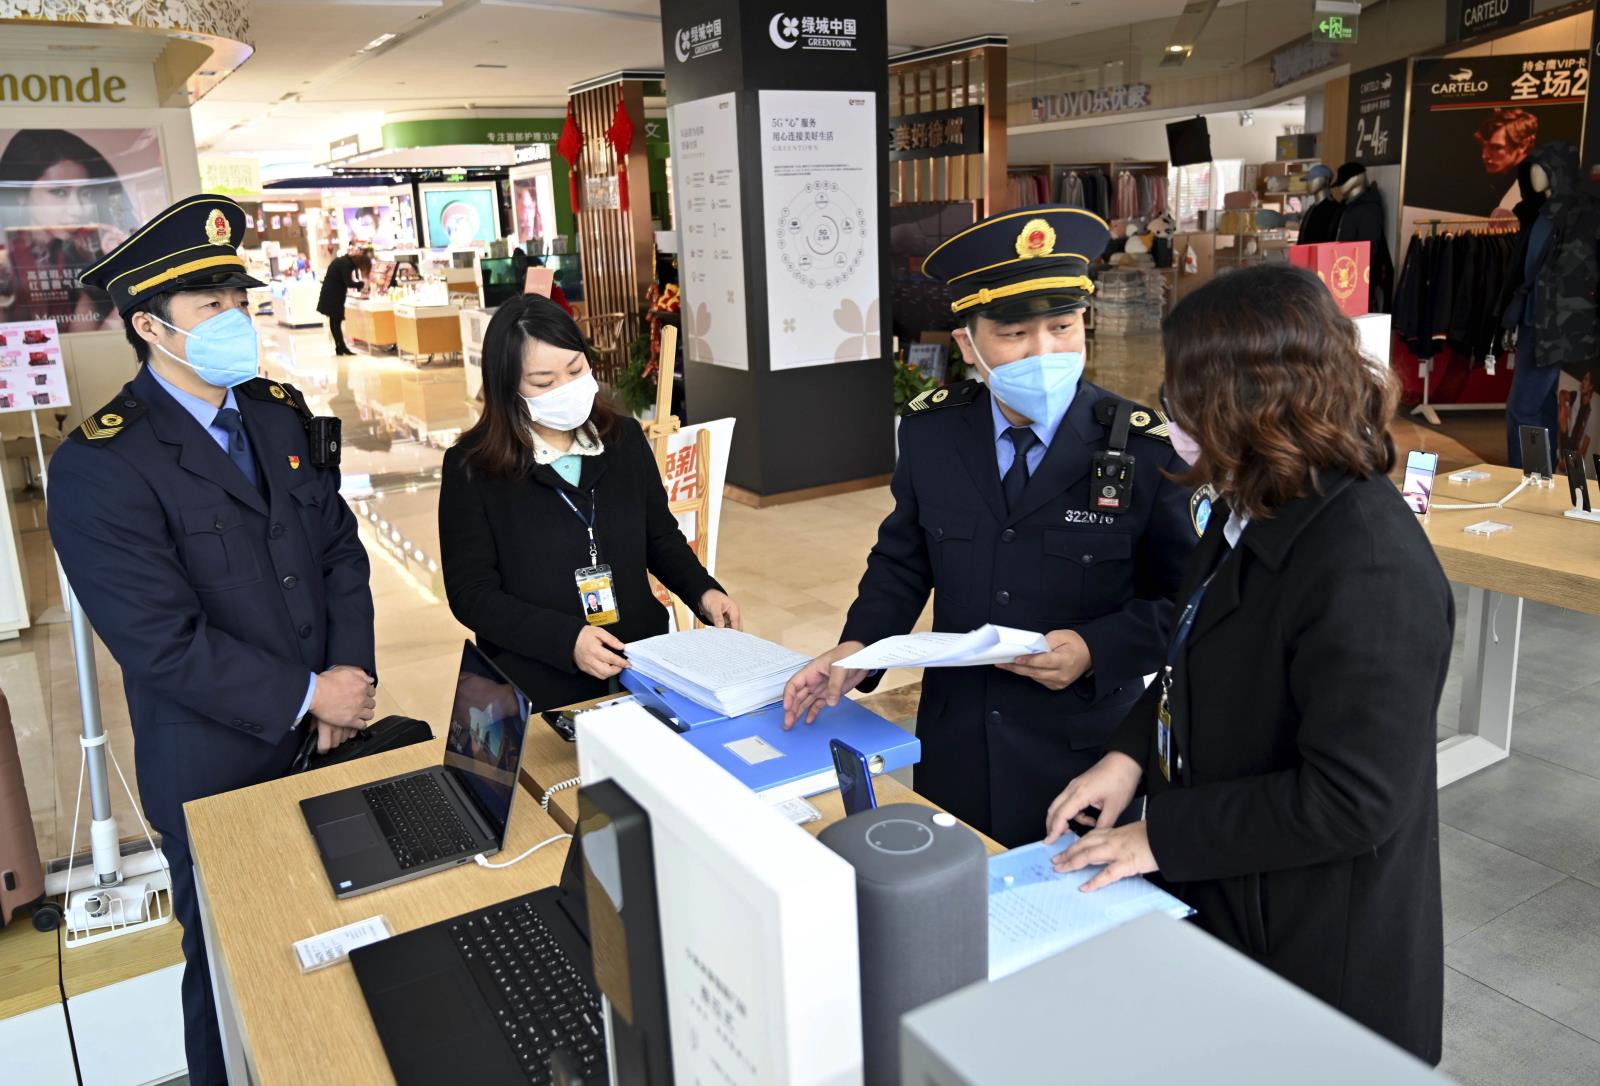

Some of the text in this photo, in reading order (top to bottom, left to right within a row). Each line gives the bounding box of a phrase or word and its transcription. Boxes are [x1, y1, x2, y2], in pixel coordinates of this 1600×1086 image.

[1464, 0, 1509, 26] CARTELO
[691, 18, 722, 43] 绿城中国
[802, 16, 857, 35] 绿城中国
[808, 38, 852, 48] GREENTOWN
[1522, 57, 1588, 72] 持金鹰VIP卡
[1431, 81, 1488, 95] CARTELO
[1510, 68, 1588, 100] 全场2
